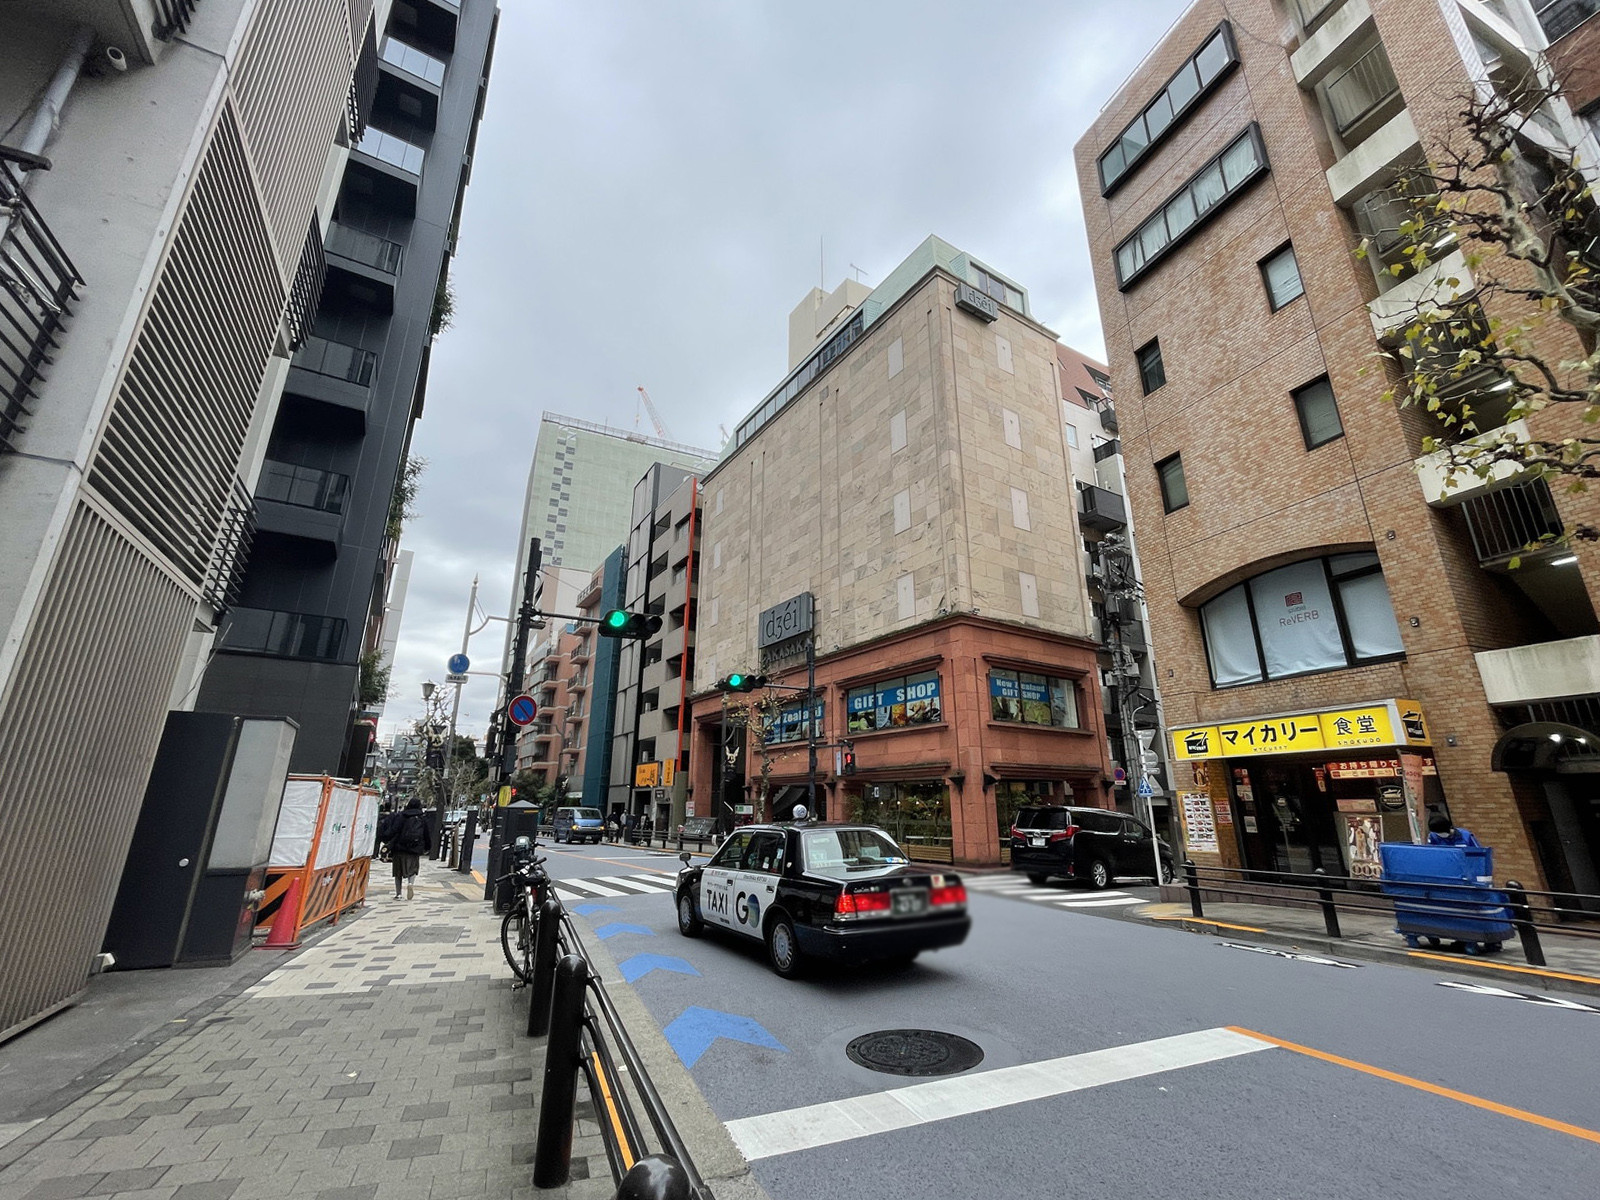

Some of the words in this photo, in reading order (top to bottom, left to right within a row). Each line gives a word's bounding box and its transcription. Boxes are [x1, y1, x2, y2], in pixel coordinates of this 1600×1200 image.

[1279, 610, 1319, 627] ReVERB
[854, 693, 884, 710] GIFT
[896, 682, 936, 702] SHOP
[1002, 688, 1018, 697] GIFT
[1022, 691, 1041, 700] SHOP
[782, 706, 822, 724] Zealad
[1221, 721, 1318, 746] マイカリー
[1333, 714, 1378, 736] 食堂
[1337, 737, 1381, 746] SHOKUDO
[706, 889, 728, 915] TAXI
[736, 891, 760, 929] GO
